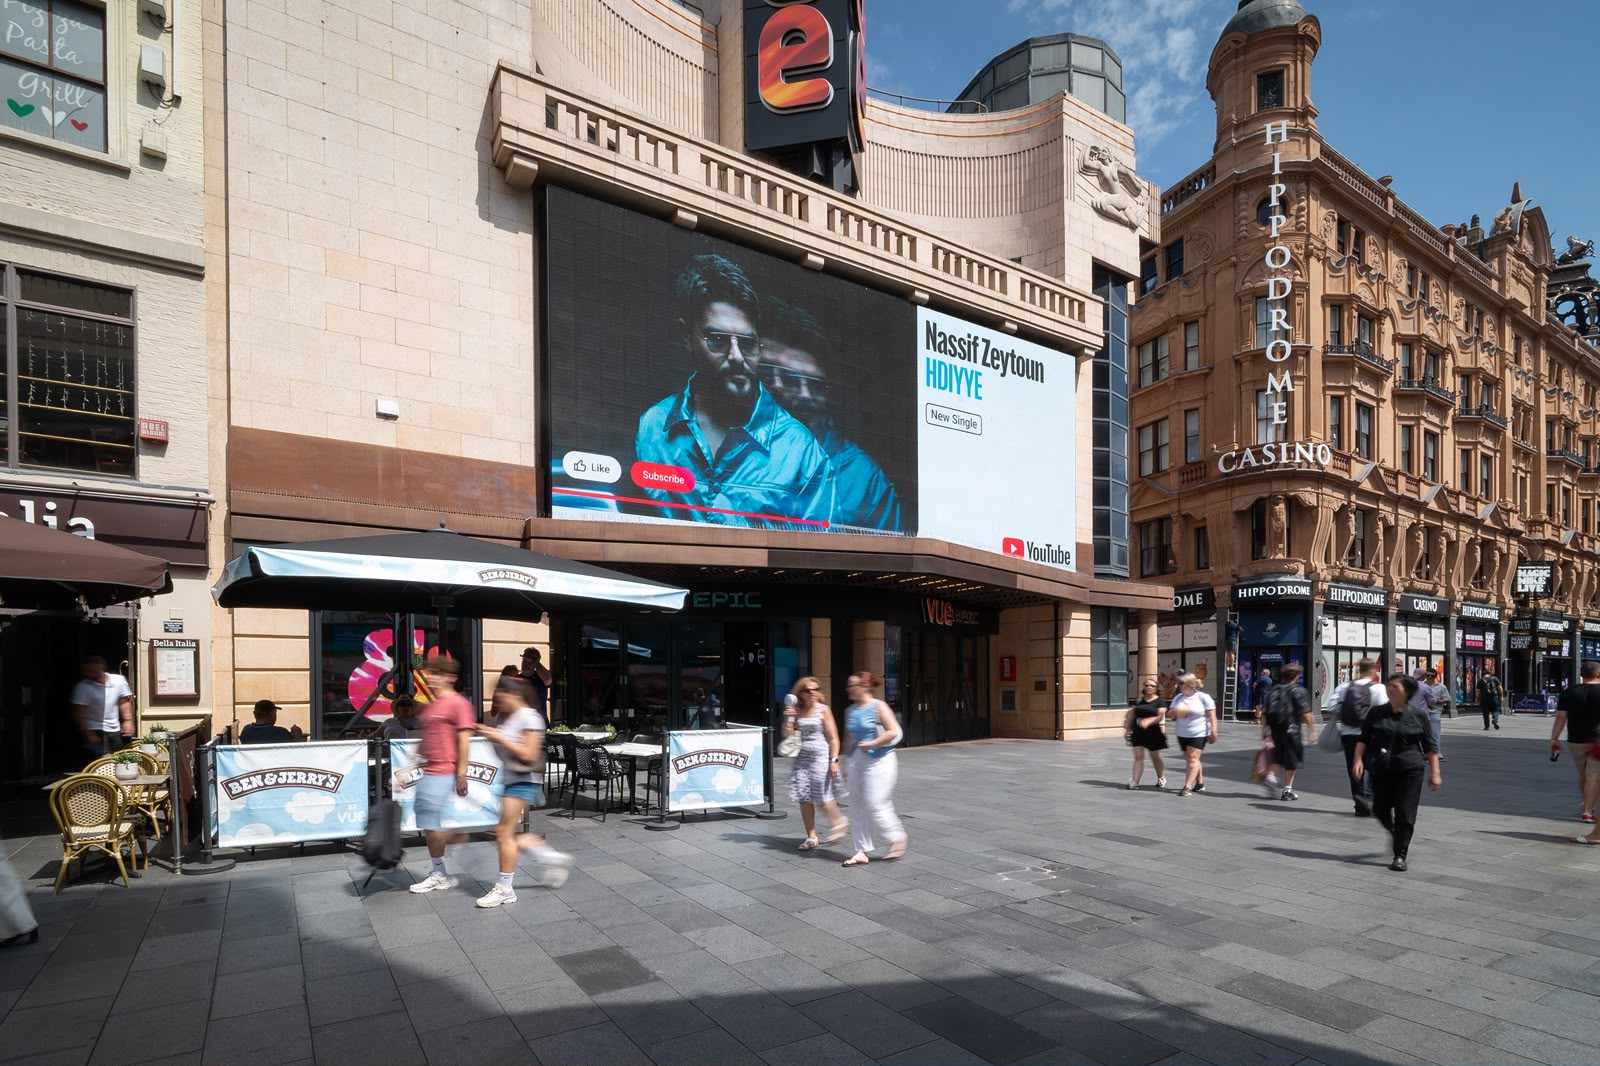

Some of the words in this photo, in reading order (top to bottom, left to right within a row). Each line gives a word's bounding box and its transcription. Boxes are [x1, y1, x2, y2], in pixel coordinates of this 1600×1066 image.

[6, 20, 84, 64] Pasta
[18, 72, 89, 108] Grill
[1264, 119, 1296, 425] HIPPODROME
[926, 320, 979, 364] Nassif
[982, 338, 1044, 383] Zeytoun
[926, 357, 982, 400] HDIYYE
[931, 409, 950, 423] New
[952, 415, 978, 430] Single
[1218, 441, 1331, 473] CASINO
[591, 463, 610, 474] Like
[642, 470, 685, 485] Subscribe
[1026, 541, 1071, 565] YouTube
[1517, 569, 1551, 577] MAGIC
[1517, 576, 1547, 585] MIKE
[1239, 586, 1310, 598] HIPPODROME
[1517, 584, 1544, 592] LIVE
[693, 592, 762, 608] EPIC
[1173, 593, 1203, 608] OME
[1330, 588, 1384, 606] HIPPODROME
[1413, 599, 1438, 612] CASINO
[1462, 605, 1499, 620] HIPPODROME
